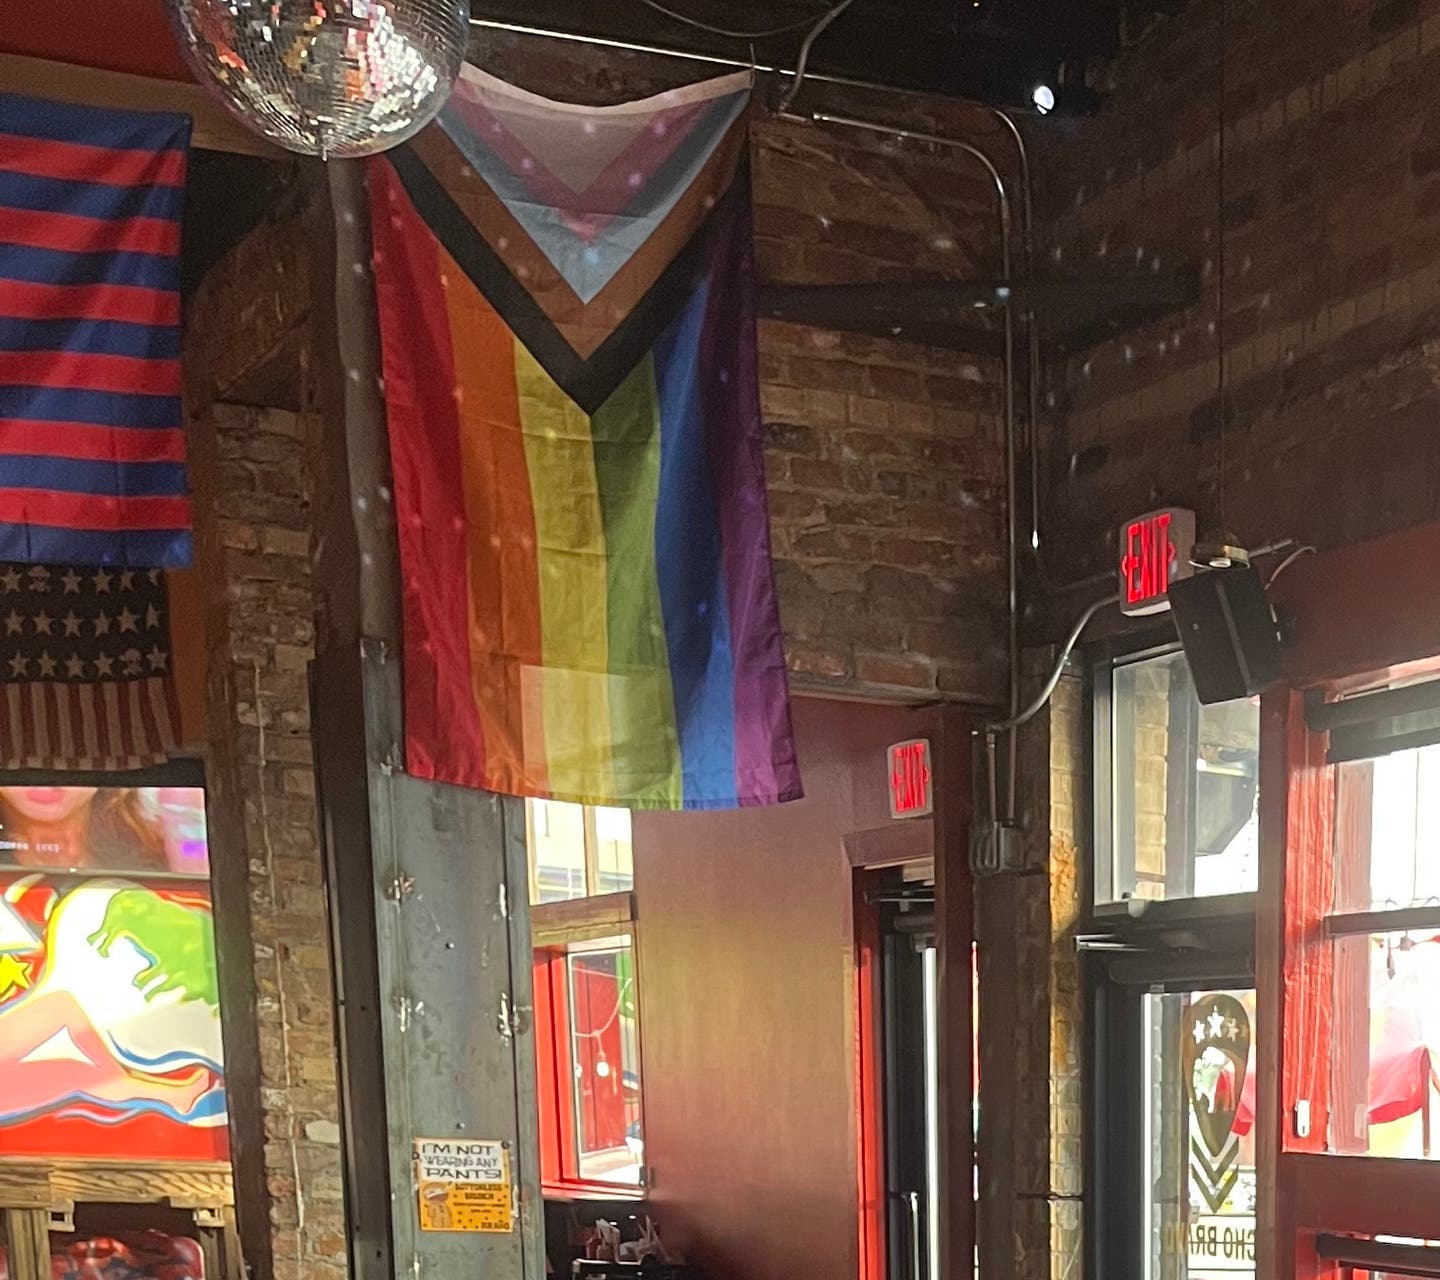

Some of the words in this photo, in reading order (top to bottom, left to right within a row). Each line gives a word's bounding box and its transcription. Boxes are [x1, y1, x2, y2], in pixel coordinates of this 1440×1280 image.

[1126, 512, 1171, 603] EXIT
[895, 743, 926, 812] EXIT
[424, 1155, 473, 1168] WEARING
[476, 1156, 498, 1169] ANY
[456, 1144, 494, 1157] NOT
